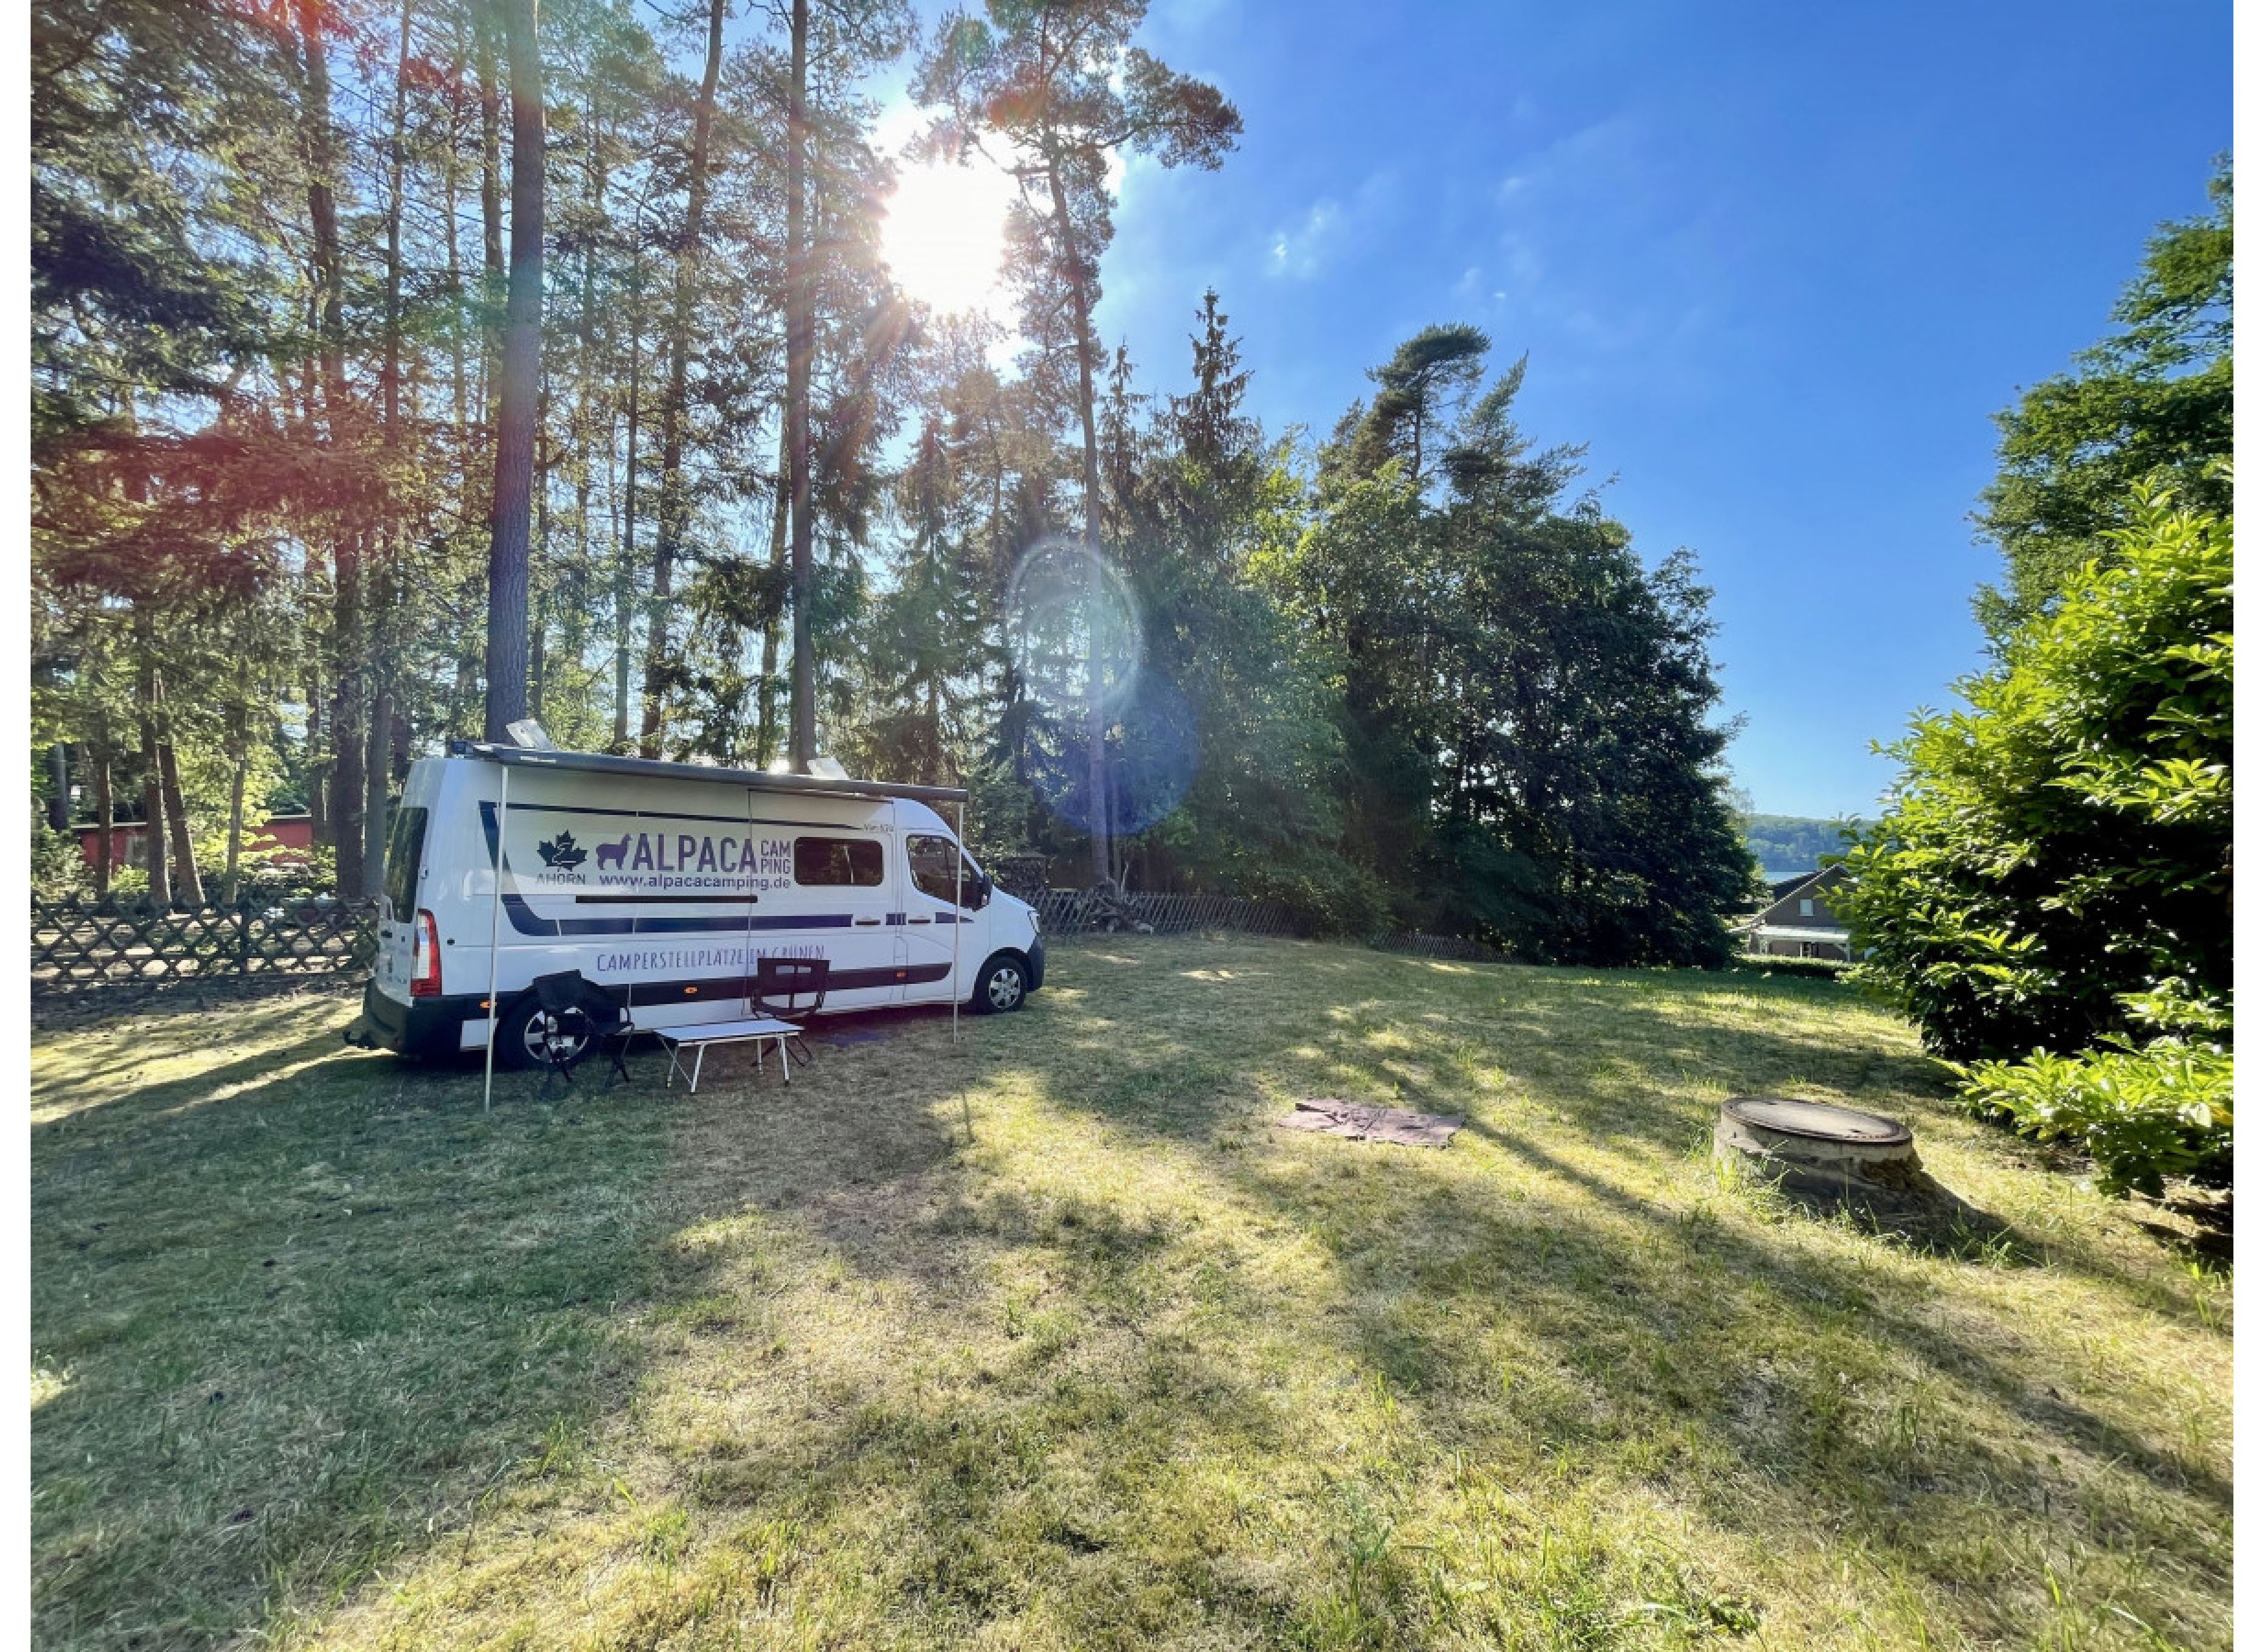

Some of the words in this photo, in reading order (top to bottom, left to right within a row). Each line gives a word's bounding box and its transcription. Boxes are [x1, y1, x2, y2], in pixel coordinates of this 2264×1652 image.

[631, 833, 758, 873] ALPACA
[761, 839, 791, 857] CAM
[761, 858, 791, 874] PING
[537, 873, 586, 885] AHORN
[599, 874, 791, 891] www.alpacacamping.de
